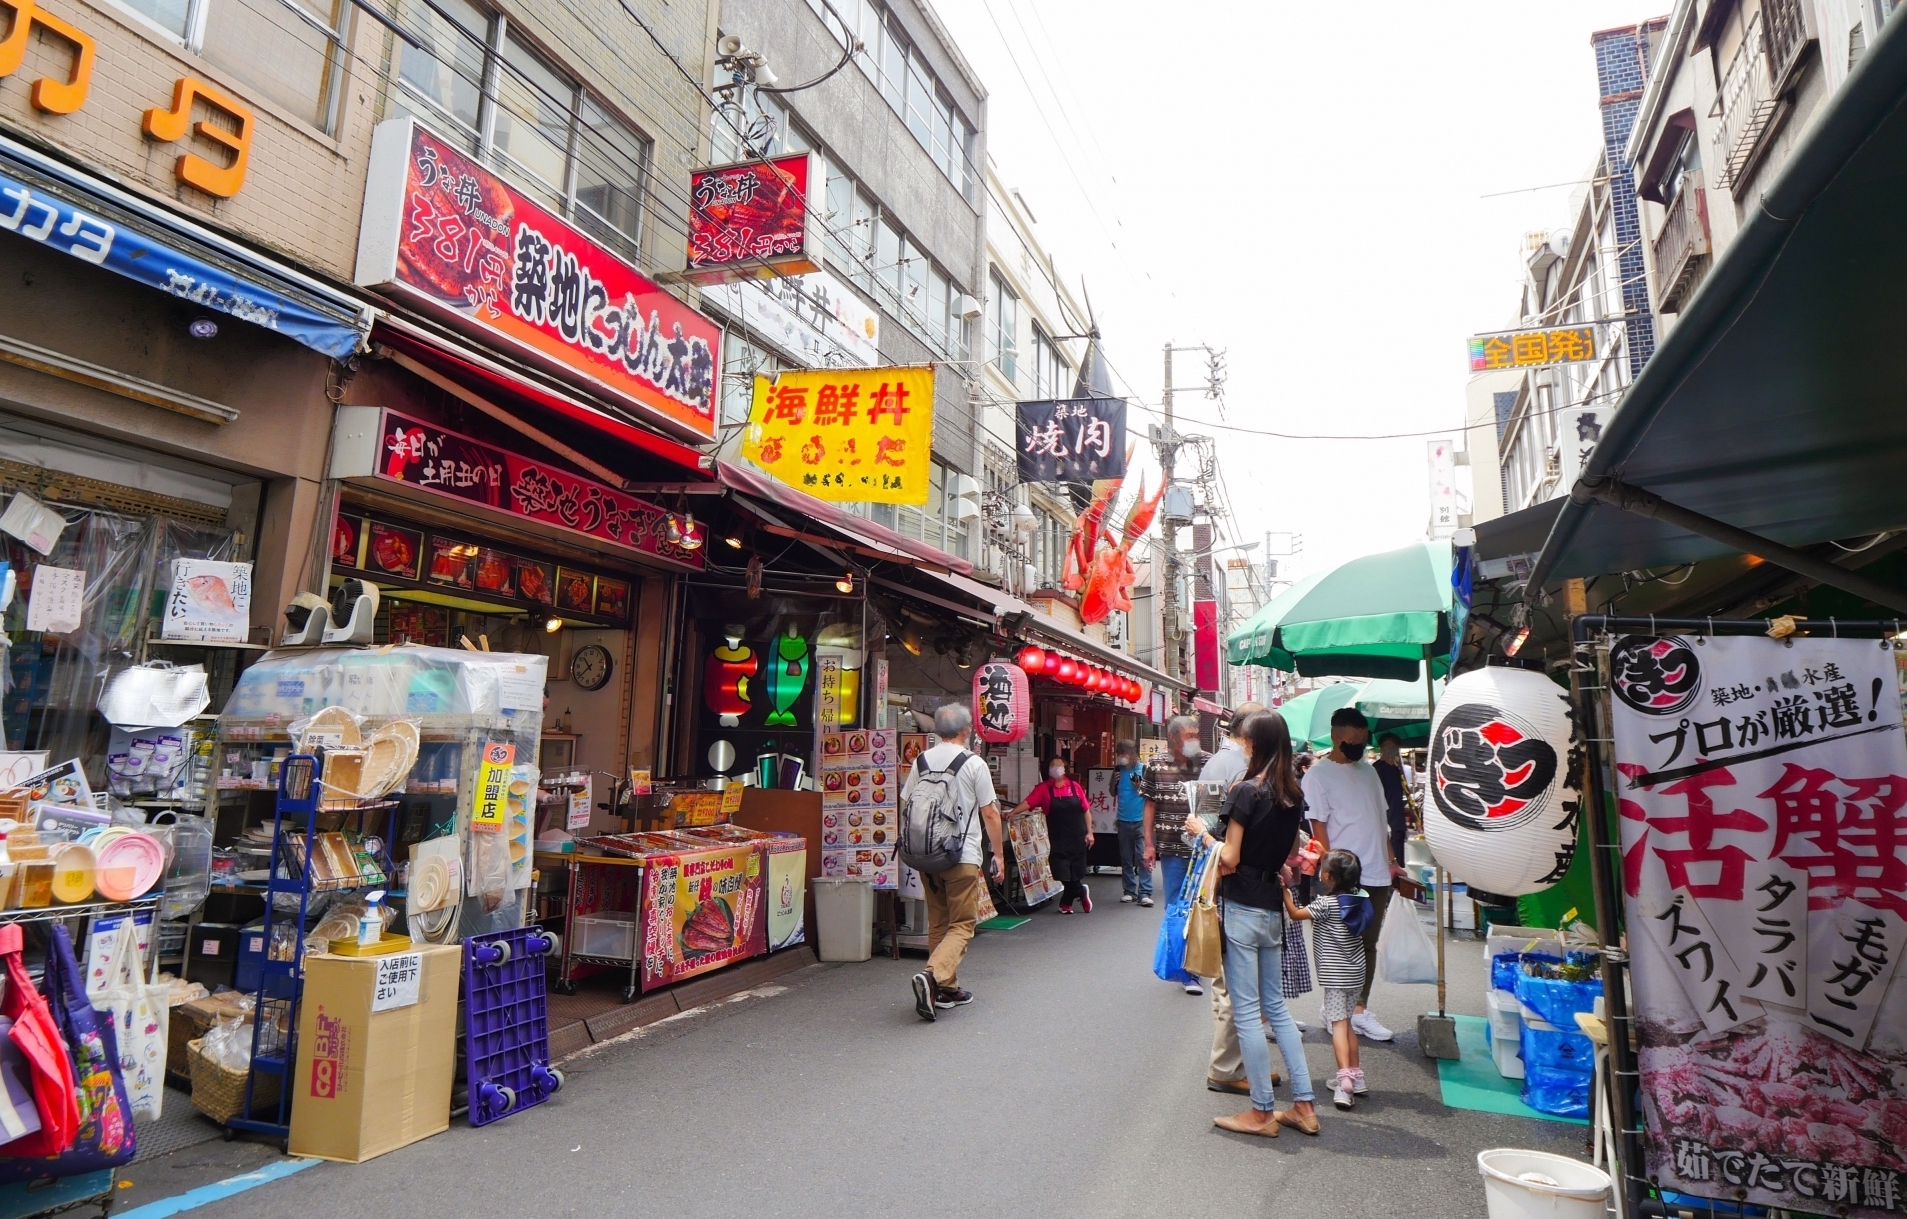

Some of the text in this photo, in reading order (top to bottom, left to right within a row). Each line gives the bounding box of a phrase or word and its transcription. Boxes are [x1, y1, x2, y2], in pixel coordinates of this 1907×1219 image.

[416, 147, 482, 216] うな丼
[697, 171, 760, 210] うな丼
[473, 206, 510, 238] UNADON
[464, 284, 503, 319] から
[763, 382, 911, 427] 海鮮丼
[1054, 402, 1089, 419] 築地
[1024, 417, 1112, 459] 焼肉
[418, 457, 502, 488] 土用丑の日
[230, 565, 248, 608] 築地に
[1710, 662, 1846, 707] 築地・水産
[1380, 707, 1410, 715] CAPTAIN
[1648, 677, 1883, 770] プロが厳選!
[481, 767, 503, 818] 加盟店
[1747, 874, 1796, 998] タラバ
[379, 956, 418, 971] 入店前に
[379, 969, 417, 985] ご使用下
[1655, 895, 1738, 1022] ズワイ
[1810, 916, 1889, 1039] 毛ガニ
[377, 987, 397, 1000] さい
[314, 1014, 330, 1058] BF
[328, 1017, 342, 1058] シリーズ
[1675, 1140, 1902, 1211] 茹でたて新鮮
